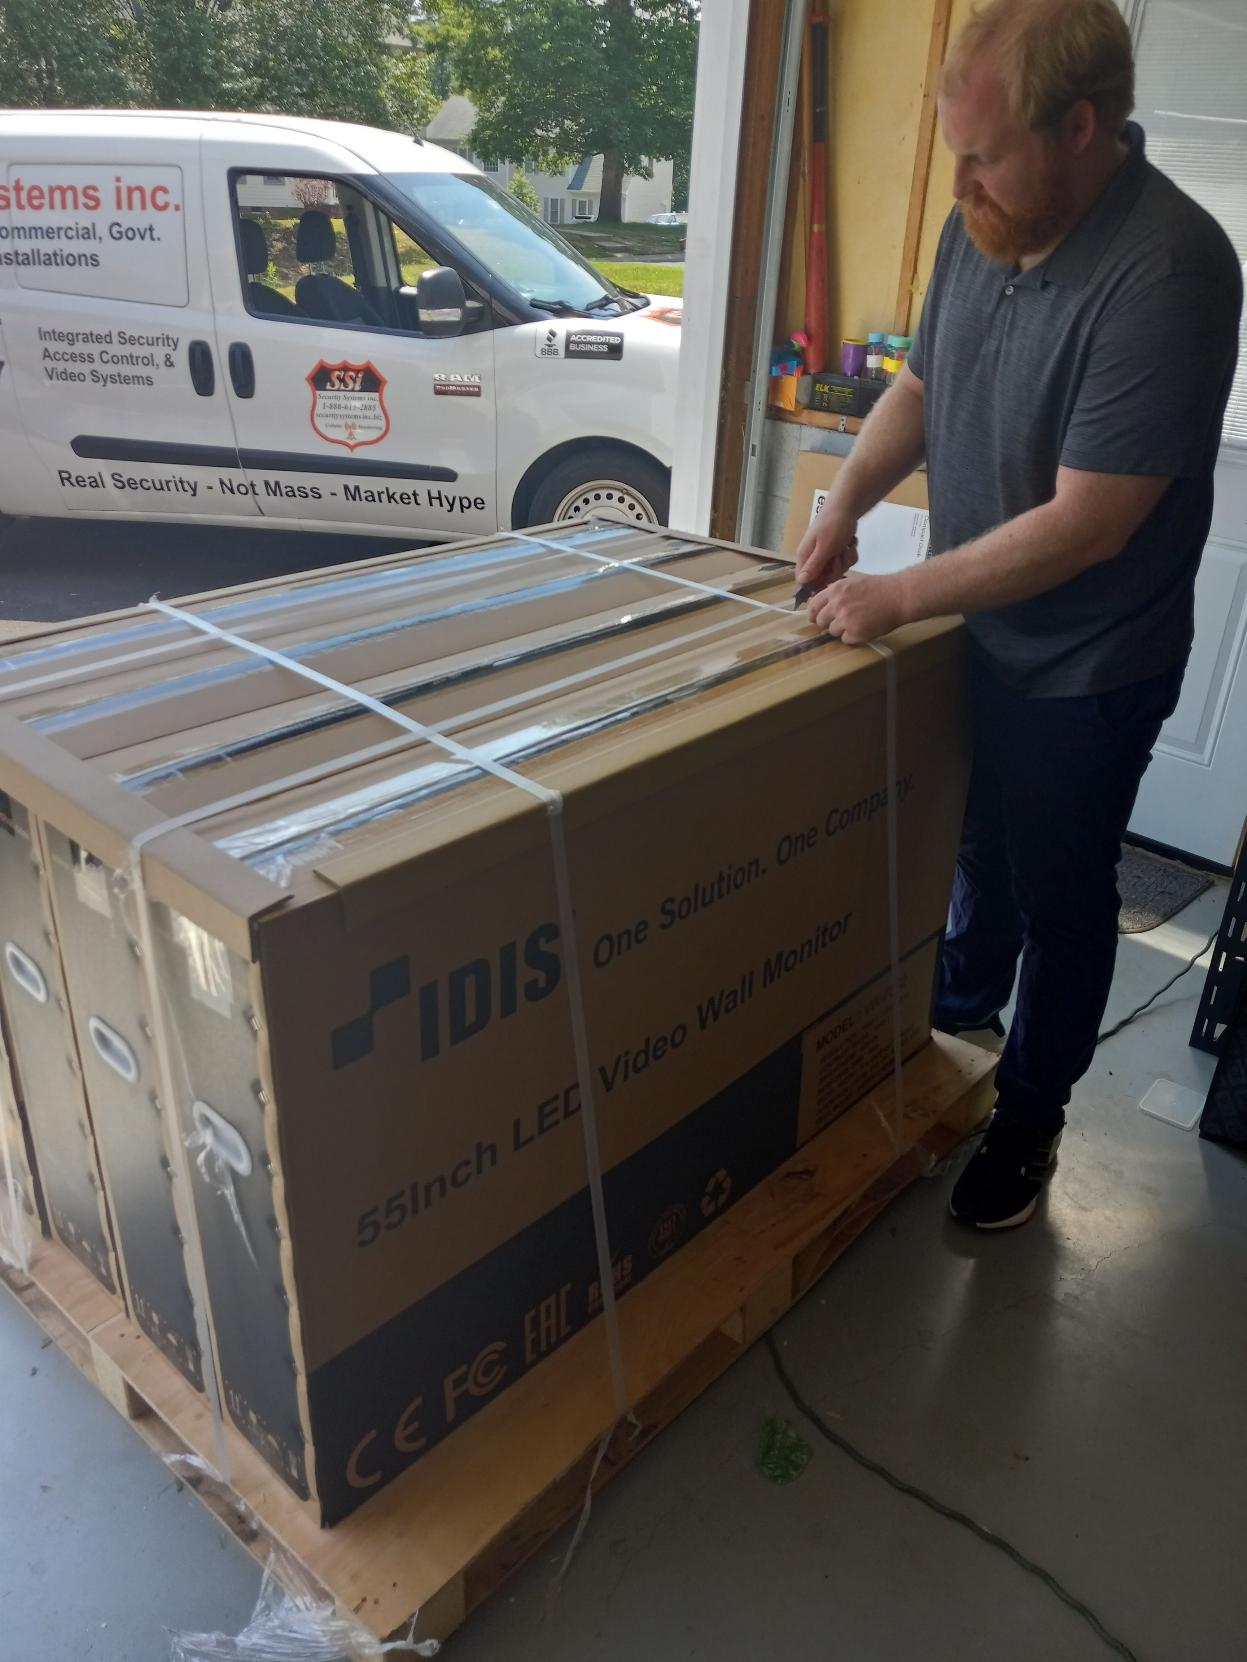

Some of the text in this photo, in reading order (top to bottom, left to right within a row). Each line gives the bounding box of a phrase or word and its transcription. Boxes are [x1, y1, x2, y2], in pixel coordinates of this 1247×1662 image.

[115, 176, 181, 212] inc.
[108, 221, 161, 242] Govt.
[38, 327, 179, 352] Integrated Security
[569, 343, 609, 352] BUSINESS
[570, 334, 621, 344] ACCREDITED
[42, 347, 175, 369] Access Control, &
[541, 347, 560, 356] BBB
[44, 366, 154, 388] Video Systems
[433, 373, 481, 383] RAM
[57, 469, 106, 489] Real
[110, 472, 199, 497] Security
[218, 477, 260, 497] Not
[263, 479, 323, 500] Mass
[342, 483, 422, 506] Market
[427, 488, 486, 514] Hype
[419, 922, 562, 1063] IDIS
[593, 919, 649, 969] One
[659, 857, 767, 930] Solution.
[776, 825, 818, 866] One
[512, 1081, 582, 1152] LED
[597, 1023, 688, 1093] Video
[696, 971, 754, 1031] Wall
[762, 911, 853, 989] Monitor
